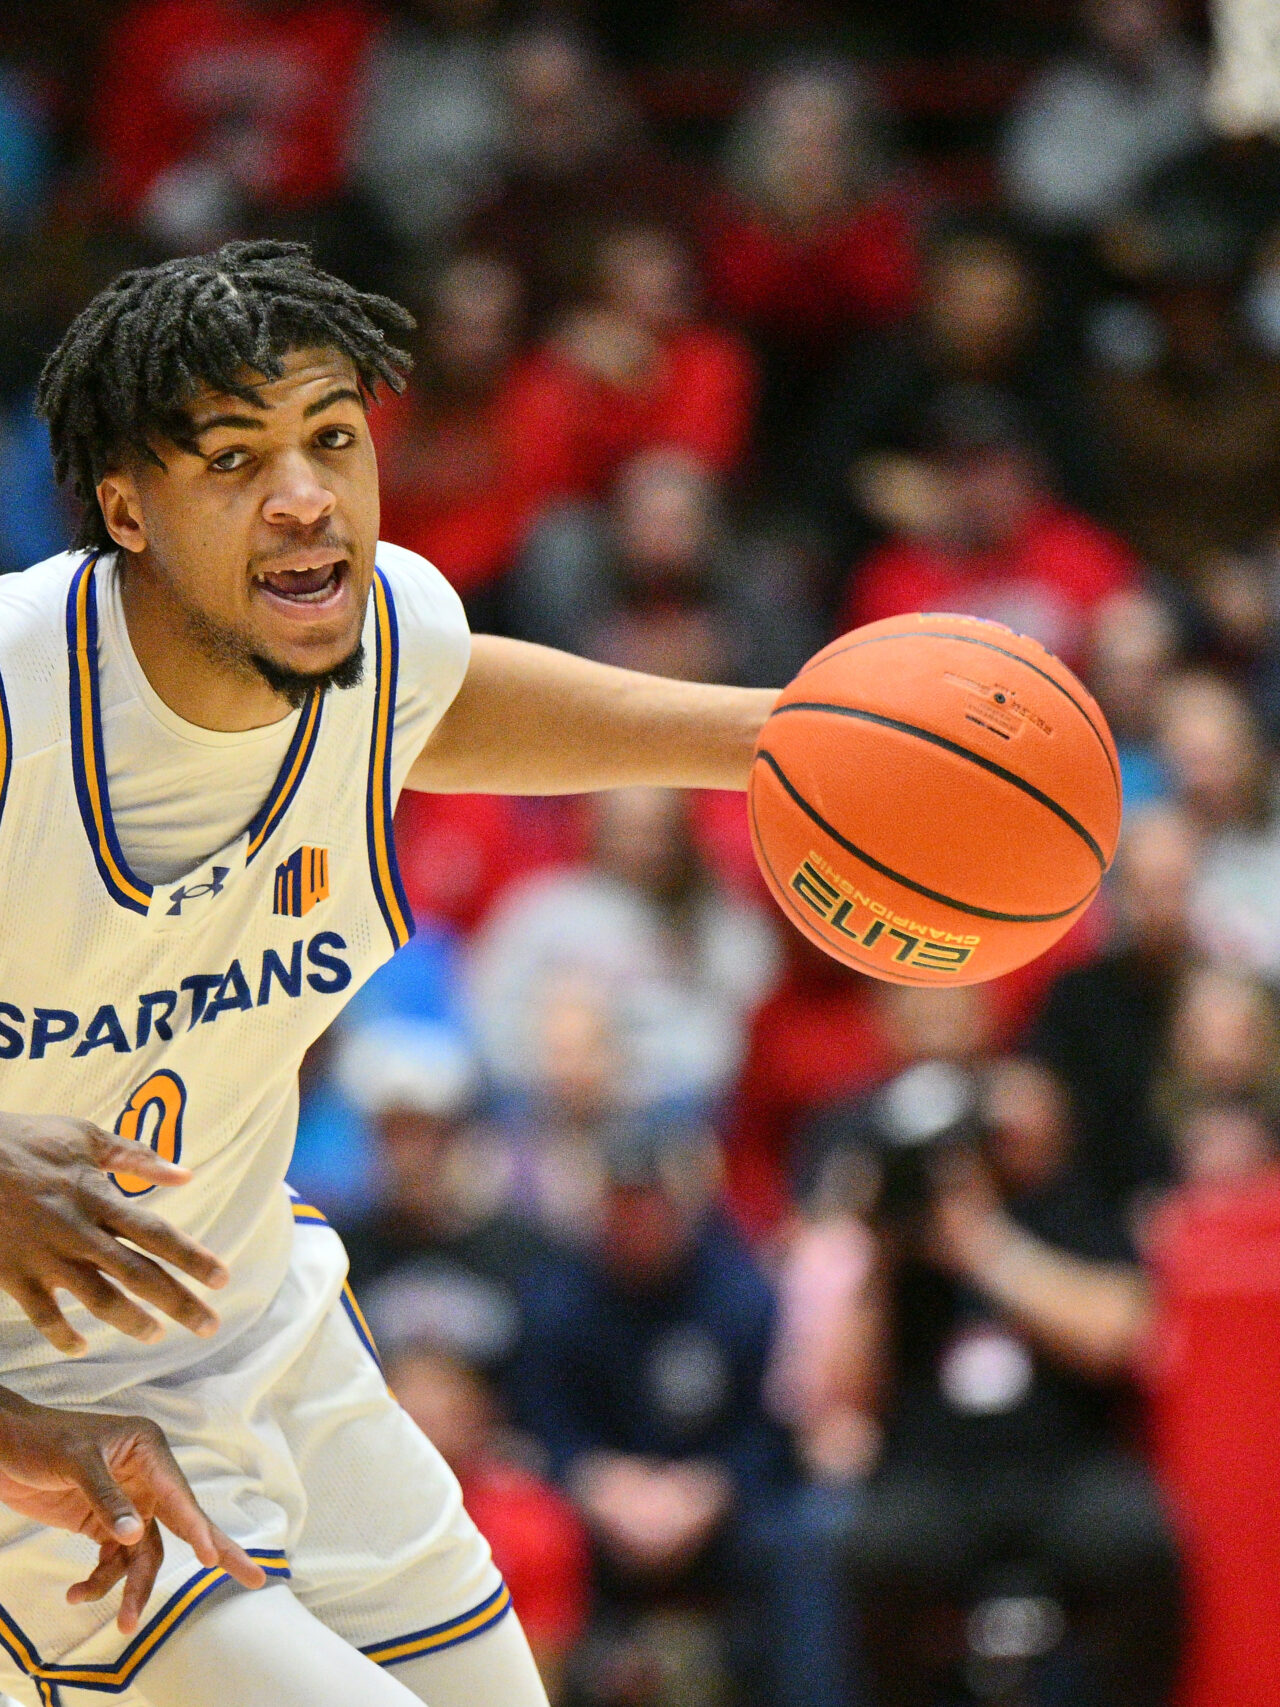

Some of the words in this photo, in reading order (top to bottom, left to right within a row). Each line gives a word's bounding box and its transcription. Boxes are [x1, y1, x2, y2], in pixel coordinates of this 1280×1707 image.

[789, 860, 976, 974] ELITE
[809, 849, 981, 945] CHAMPIONSHIP
[107, 1068, 187, 1198] 0
